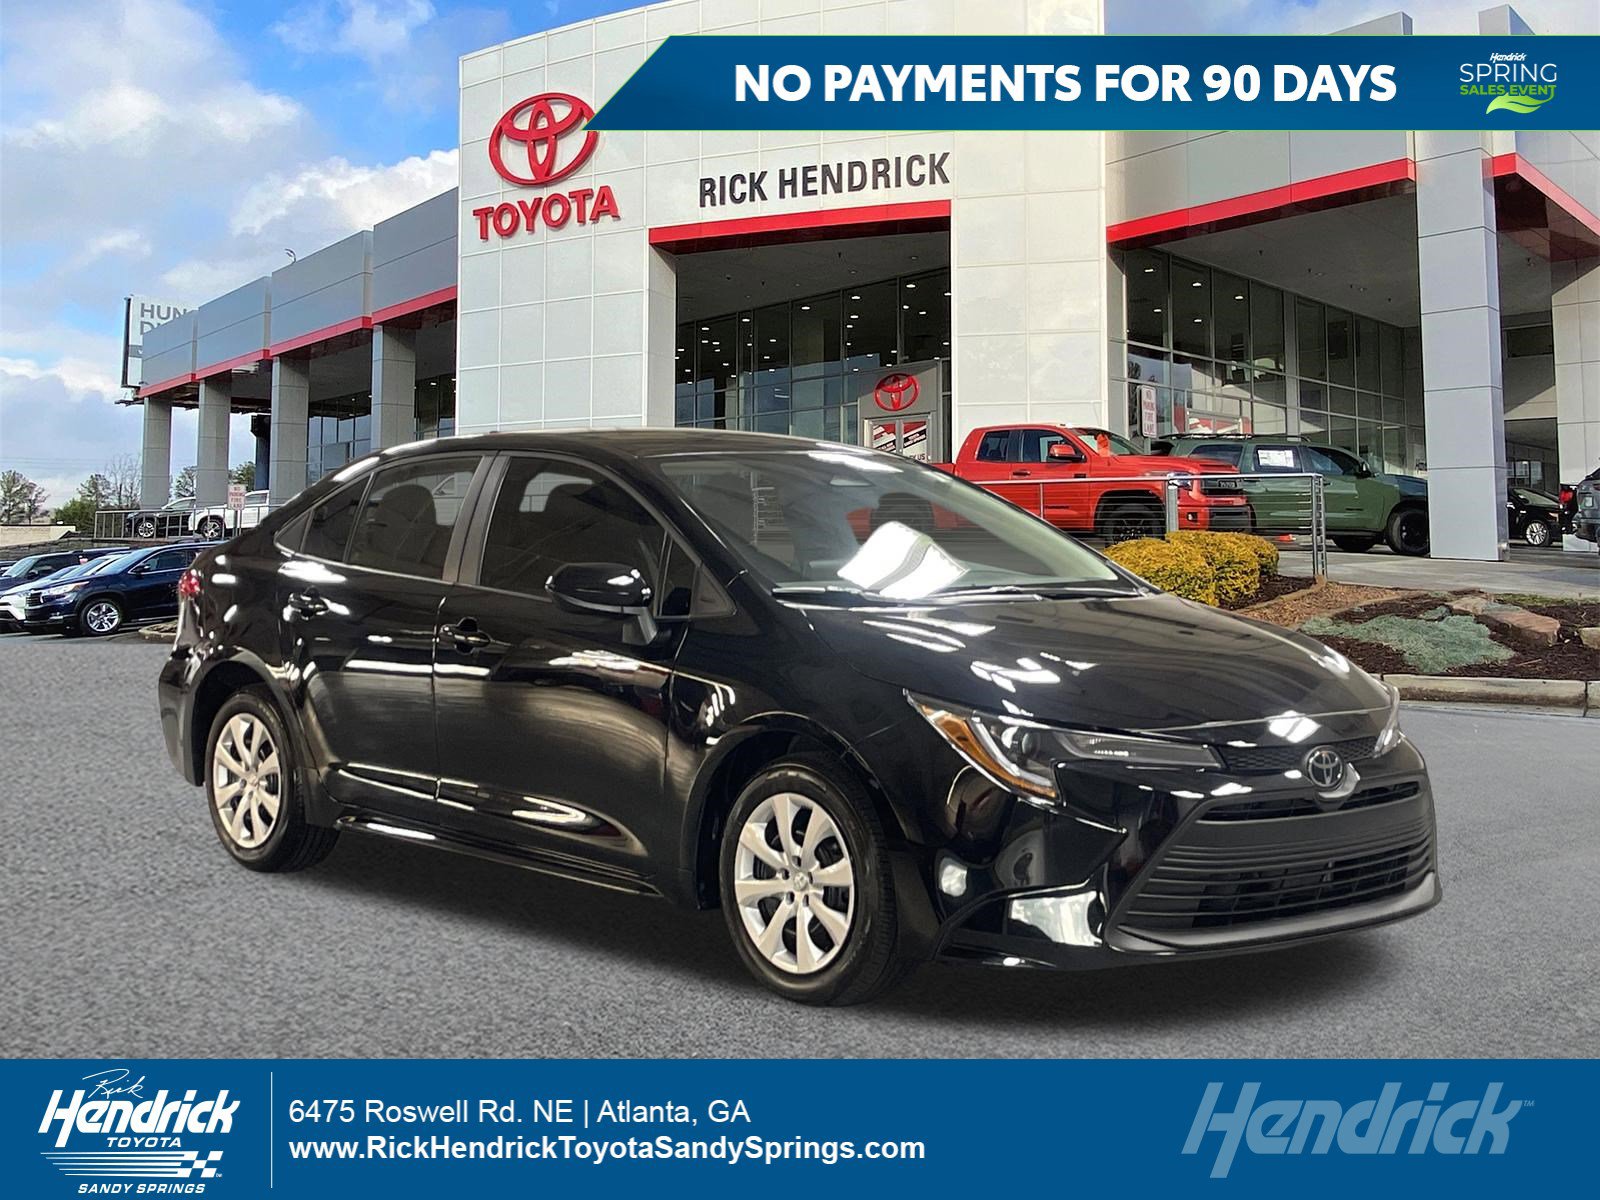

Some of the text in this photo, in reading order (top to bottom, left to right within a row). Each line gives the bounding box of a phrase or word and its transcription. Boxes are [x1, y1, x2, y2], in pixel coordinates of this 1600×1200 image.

[699, 151, 950, 208] RICK HENDRICK
[473, 184, 620, 240] TOYOTA
